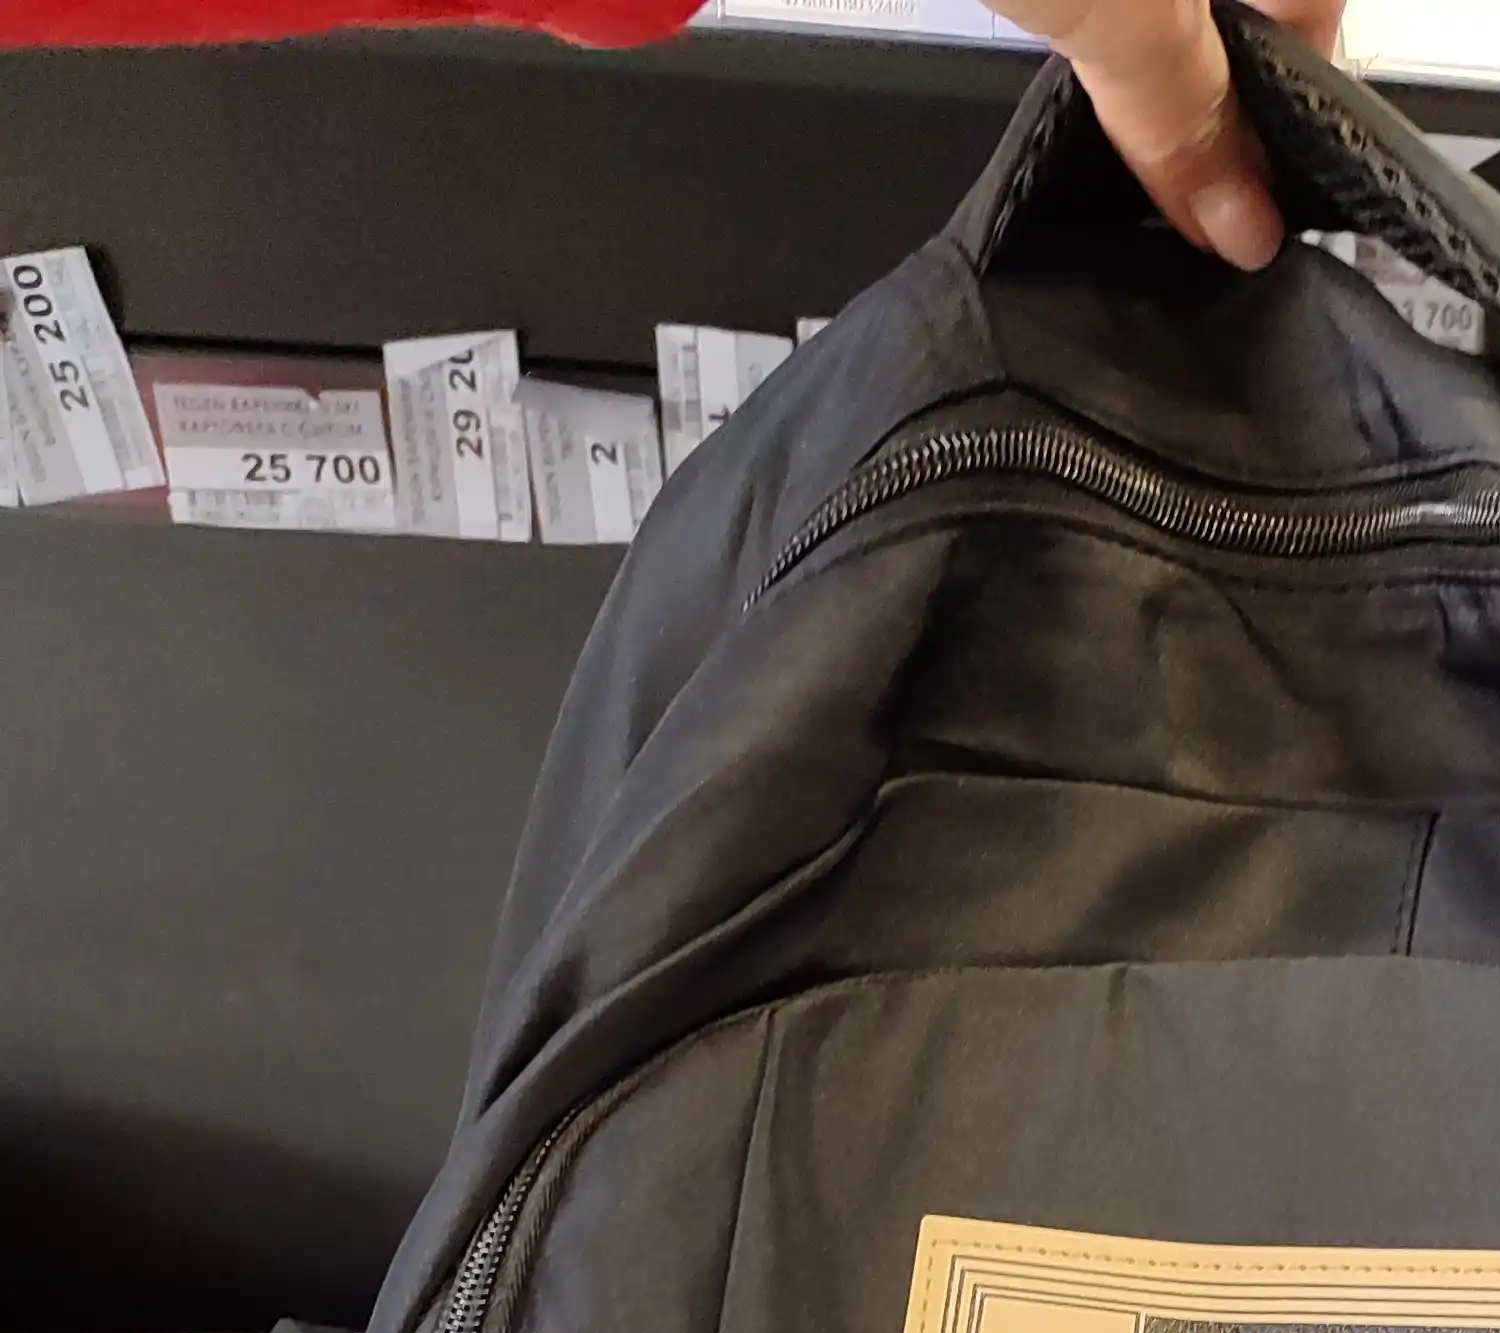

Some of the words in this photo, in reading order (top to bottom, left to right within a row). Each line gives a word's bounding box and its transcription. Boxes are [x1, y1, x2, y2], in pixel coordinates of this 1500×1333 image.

[13, 265, 66, 343] 200
[1426, 302, 1472, 331] 700
[50, 359, 90, 413] 25
[453, 409, 484, 460] 29
[242, 453, 291, 483] 25
[306, 454, 380, 484] 700
